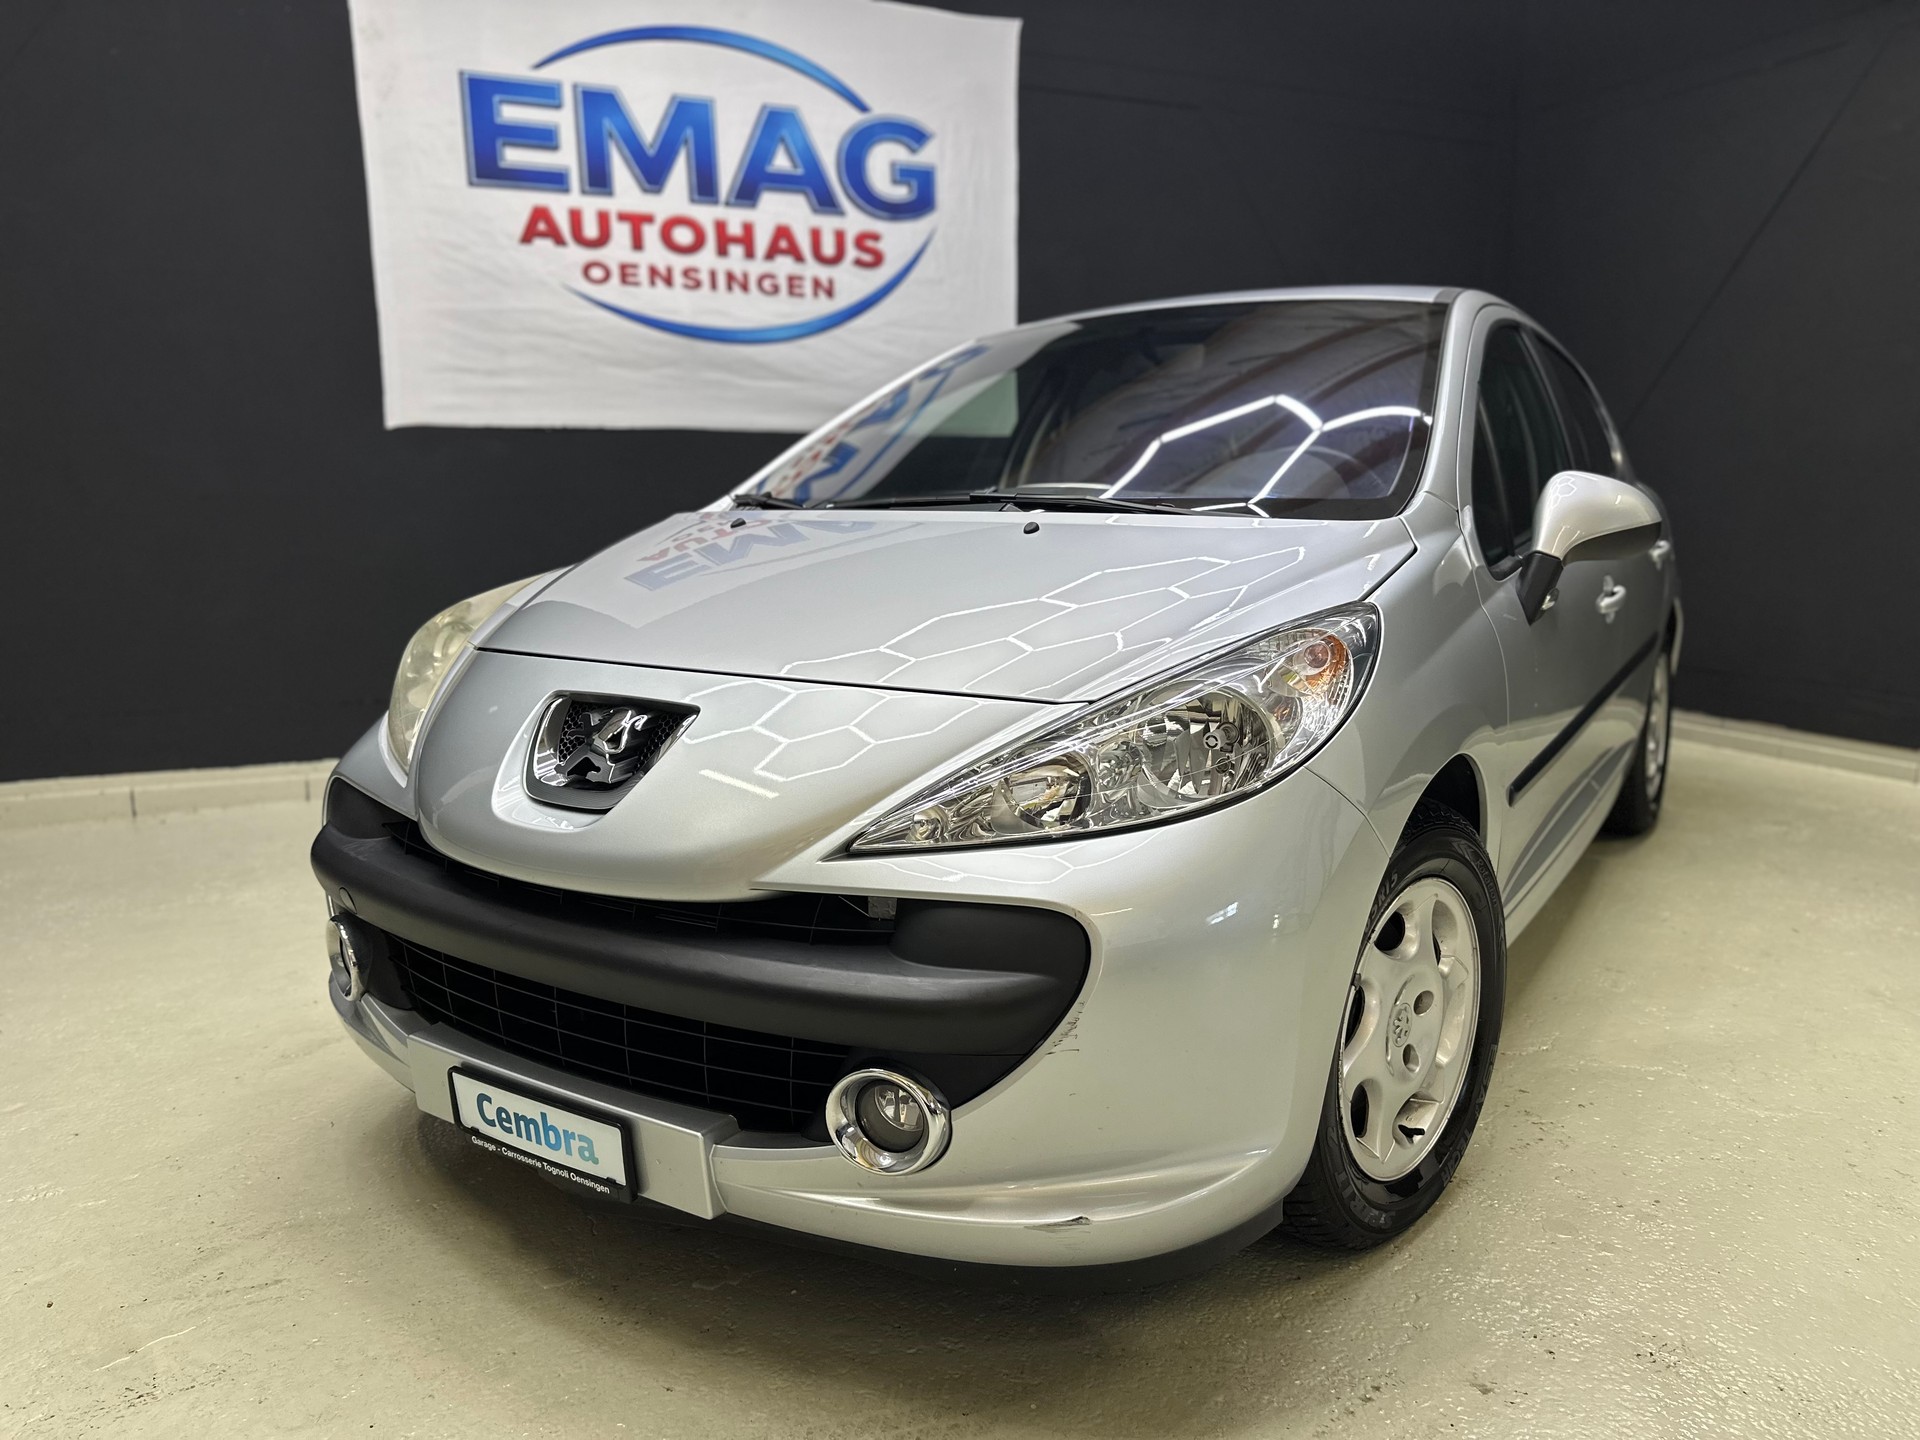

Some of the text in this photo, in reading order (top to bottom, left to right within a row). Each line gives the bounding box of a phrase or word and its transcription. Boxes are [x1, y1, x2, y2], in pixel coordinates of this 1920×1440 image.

[459, 70, 937, 220] EMAG
[519, 206, 884, 269] AUTOHAUS
[583, 261, 835, 299] OENSINGEN
[476, 1092, 600, 1166] Cembra
[471, 1135, 497, 1152] Garage
[501, 1146, 543, 1169] Carrosserie
[542, 1161, 571, 1180] Tognoli
[569, 1171, 611, 1195] Oensingen
